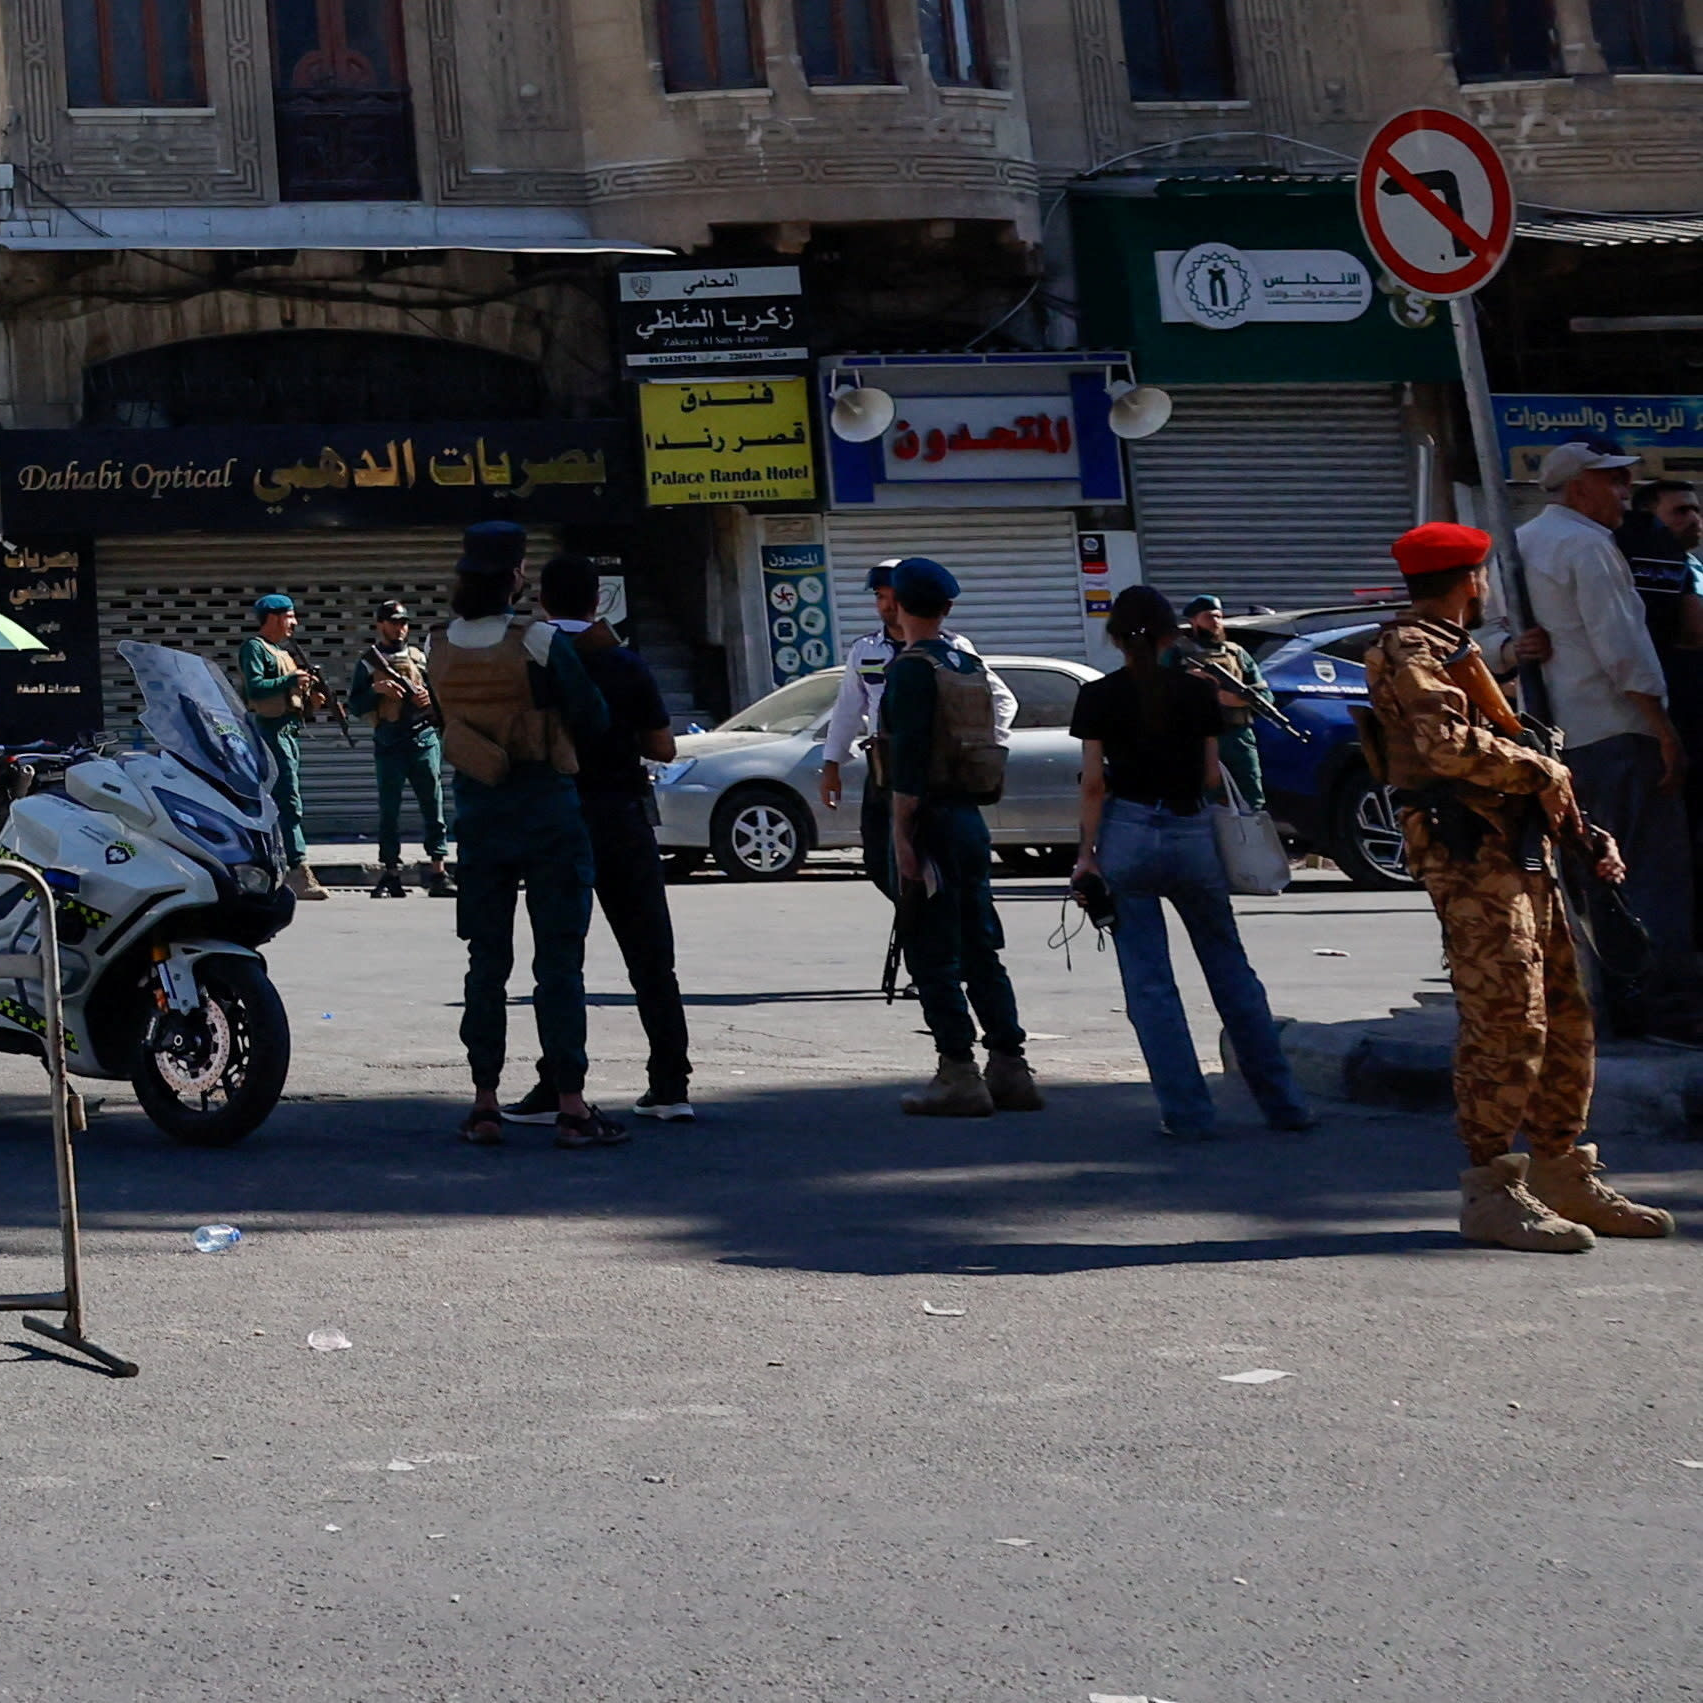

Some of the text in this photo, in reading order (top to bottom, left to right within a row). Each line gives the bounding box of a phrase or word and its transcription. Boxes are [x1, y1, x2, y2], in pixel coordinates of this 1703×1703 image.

[682, 272, 739, 296] المحامي
[721, 306, 794, 332] زكريا
[680, 383, 775, 414] فندق
[1614, 405, 1685, 434] للرياضة
[645, 422, 806, 453] قصر رندا
[893, 412, 1072, 464] المتحدون
[17, 457, 238, 499] Dahabi Optical
[253, 436, 607, 514] بصريات الدهبي
[651, 464, 809, 486] Palace Randa Hotel
[768, 551, 819, 568] المتحدون
